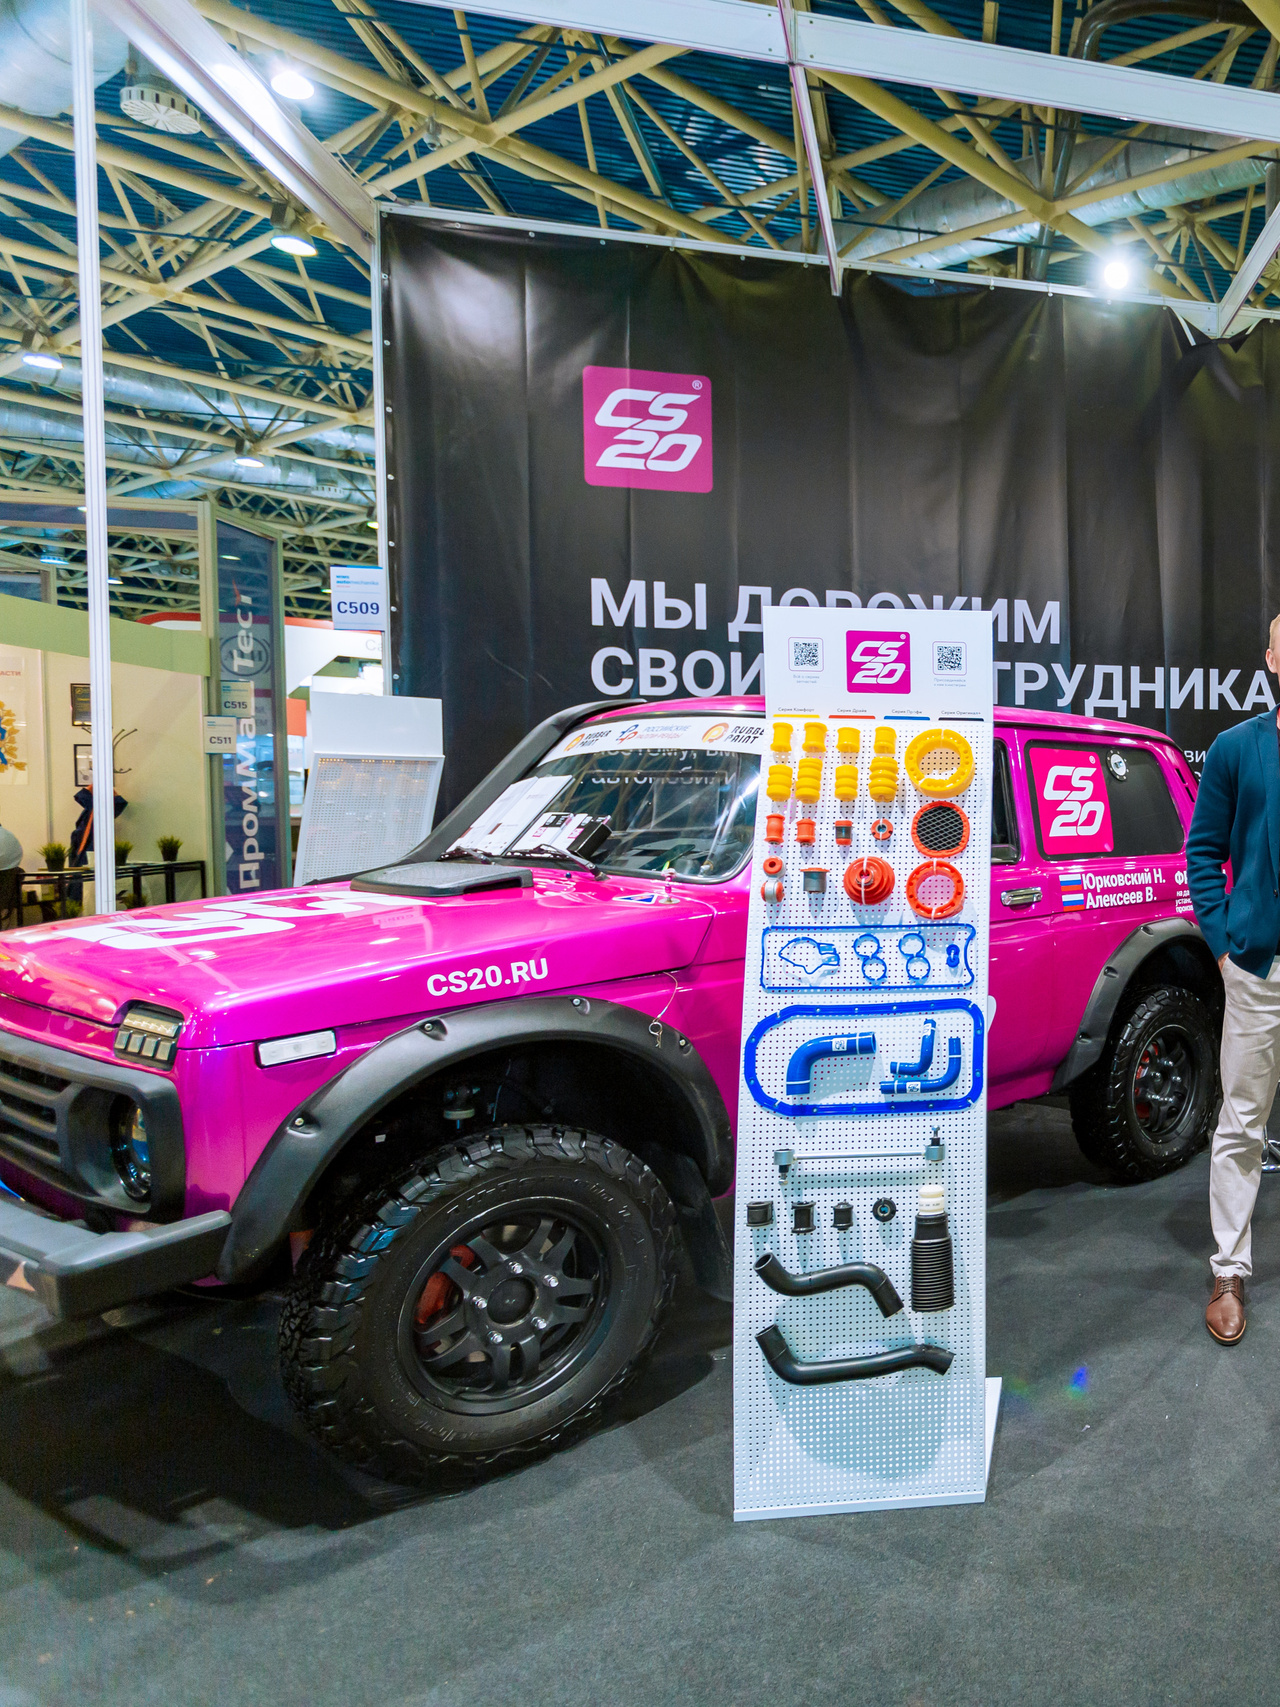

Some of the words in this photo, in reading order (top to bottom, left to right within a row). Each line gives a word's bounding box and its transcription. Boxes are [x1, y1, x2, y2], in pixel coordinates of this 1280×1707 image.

[595, 388, 701, 432] CS
[596, 429, 702, 472] 20
[337, 601, 380, 615] C509
[591, 578, 707, 630] МЫ
[851, 640, 906, 663] CS
[591, 647, 765, 697] СВОИ
[852, 663, 906, 684] 20
[223, 701, 248, 710] C515
[209, 736, 232, 745] C511
[731, 725, 765, 736] RUBBE
[1043, 765, 1097, 801] CS
[1049, 800, 1105, 838] 20
[1082, 869, 1151, 891] Юрковский
[1153, 868, 1166, 884] Н.
[1085, 890, 1143, 909] Алексеев
[1146, 886, 1158, 902] В.
[426, 958, 549, 997] CS20.RU
